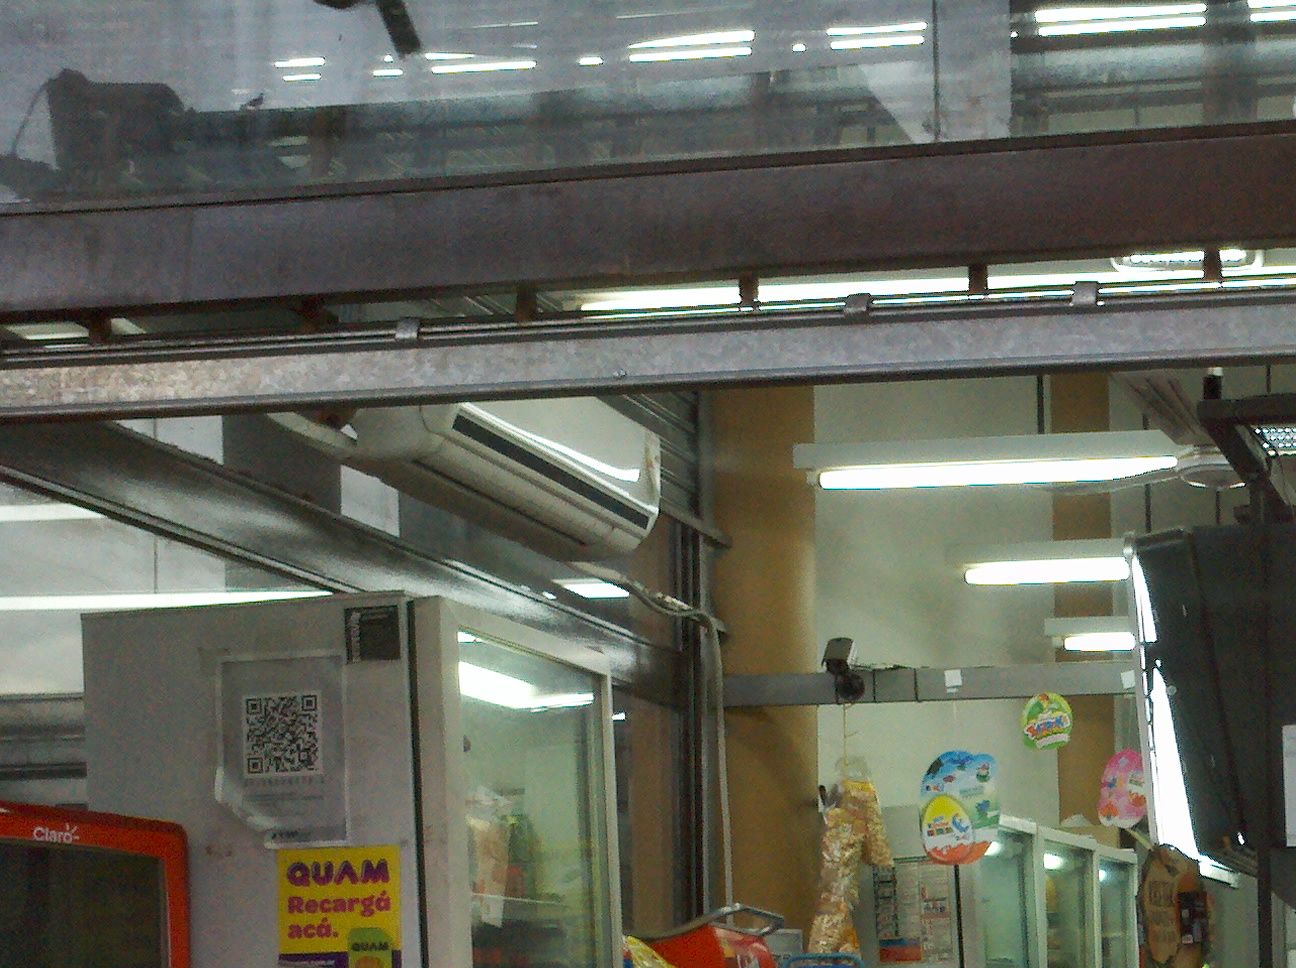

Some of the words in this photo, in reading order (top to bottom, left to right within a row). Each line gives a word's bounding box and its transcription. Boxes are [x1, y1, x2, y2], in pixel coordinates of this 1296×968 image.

[33, 823, 80, 844] Claro
[287, 859, 390, 887] QUAM
[287, 890, 391, 918] Recargá
